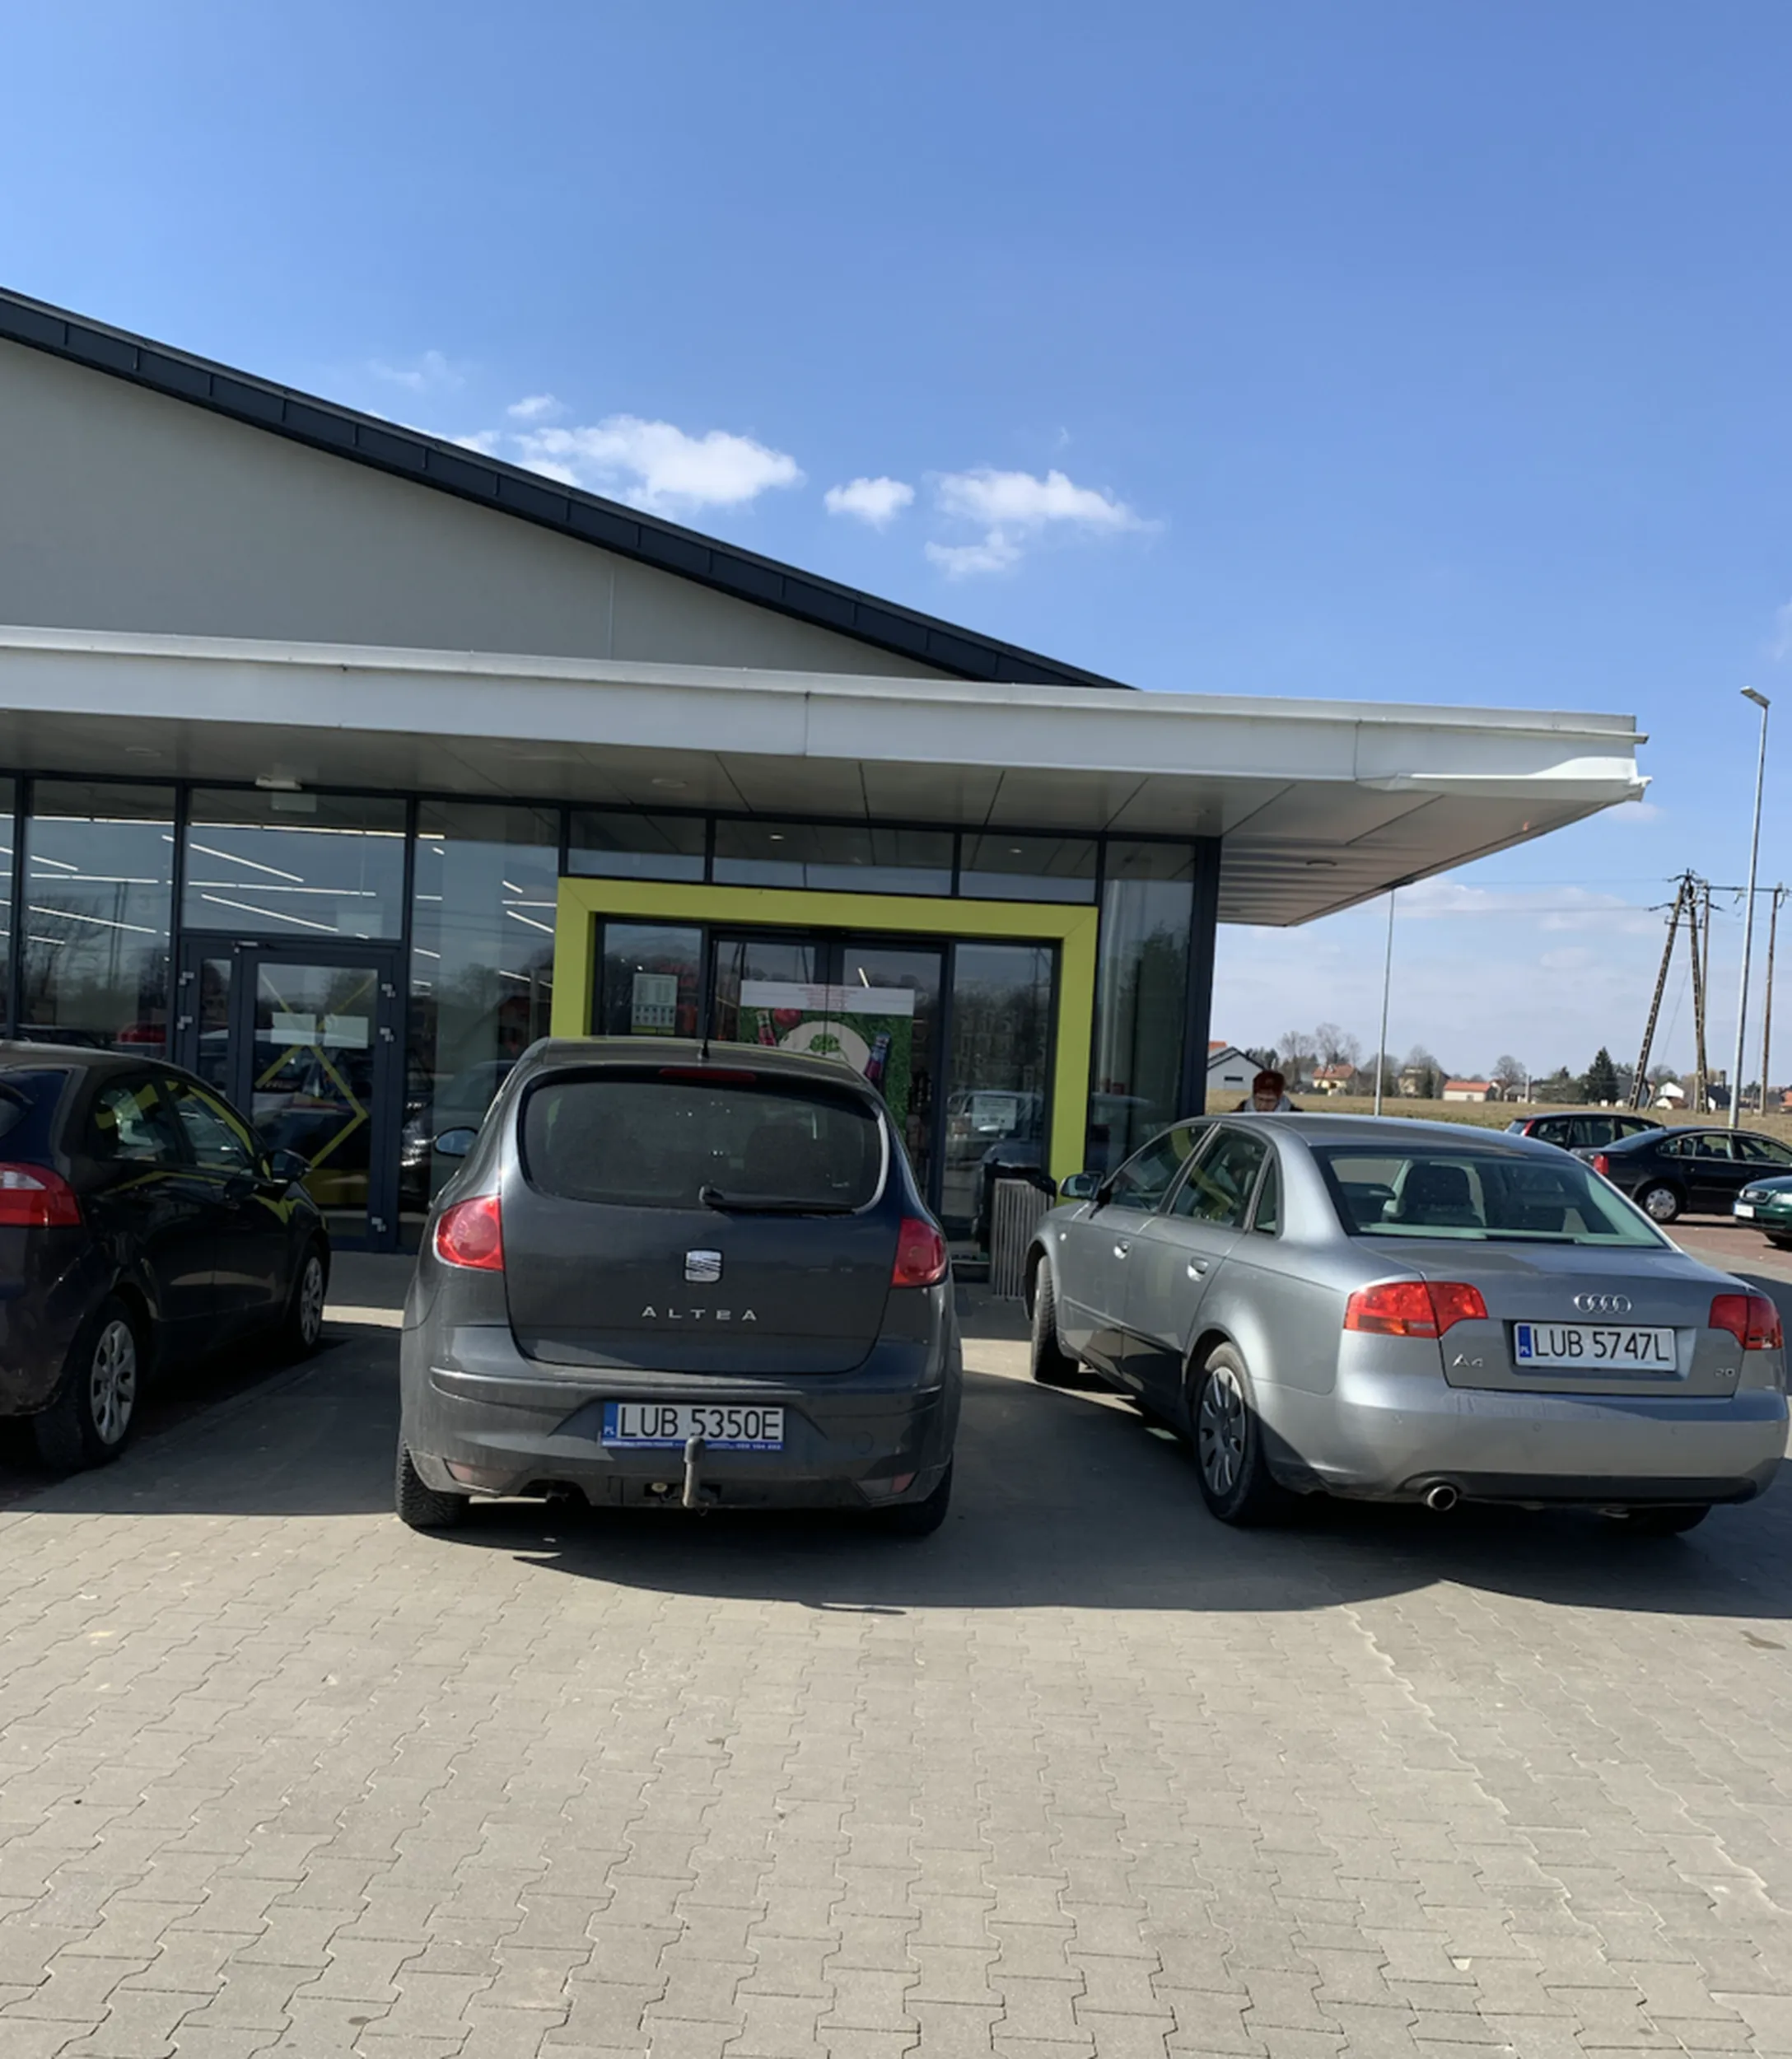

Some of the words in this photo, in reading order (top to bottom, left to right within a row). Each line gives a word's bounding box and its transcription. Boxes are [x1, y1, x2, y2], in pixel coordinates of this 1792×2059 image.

[642, 1306, 757, 1321] ALTEA
[1533, 1328, 1584, 1357] LUB
[1592, 1331, 1670, 1361] 5747L
[1452, 1353, 1483, 1368] A4
[620, 1407, 679, 1438] LUB
[689, 1408, 780, 1440] 5350E
